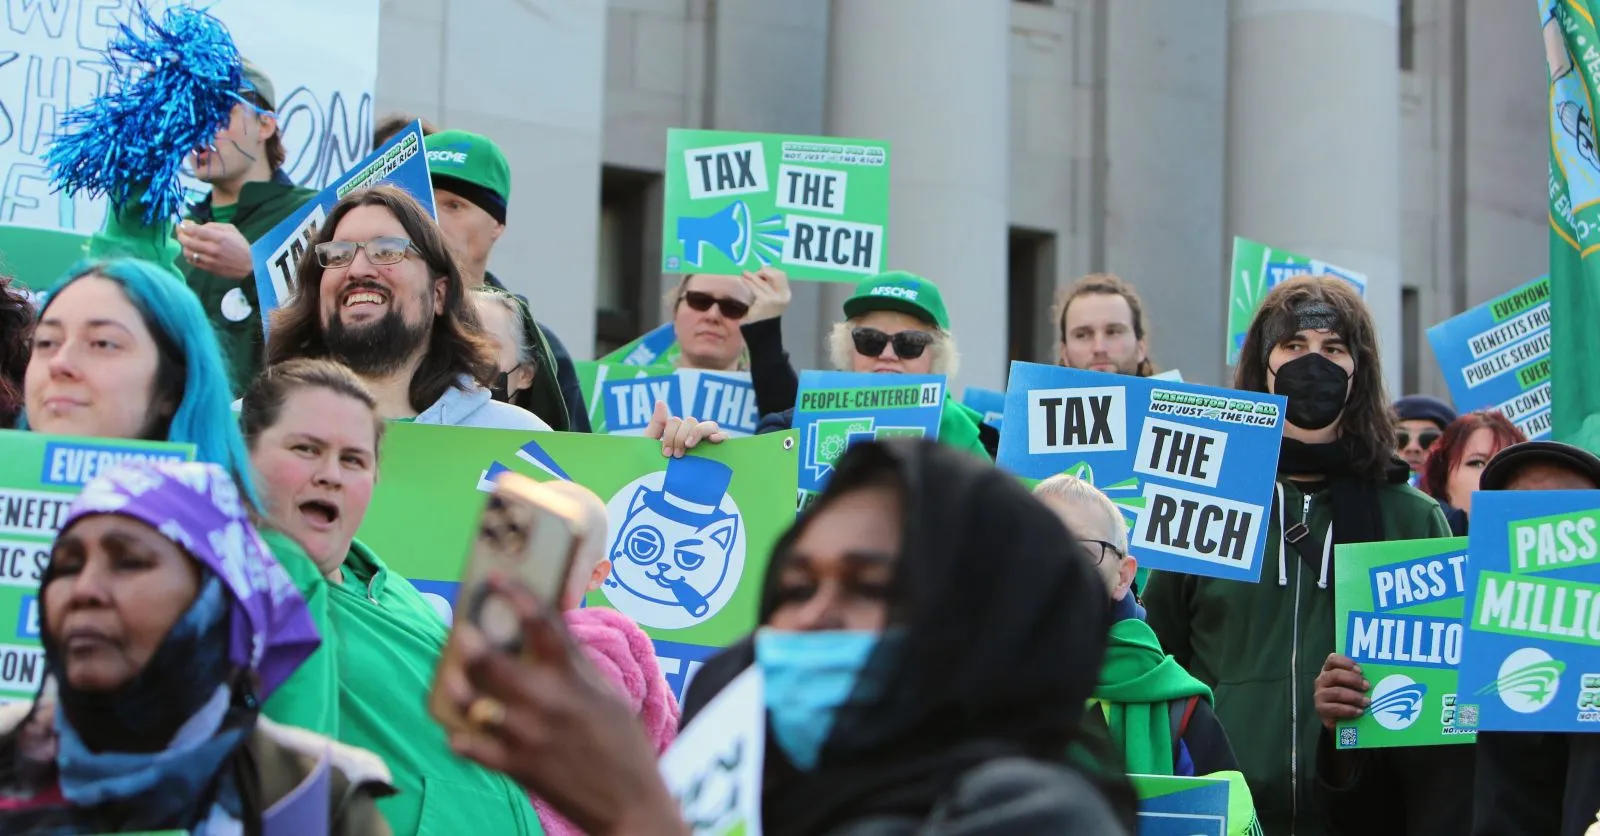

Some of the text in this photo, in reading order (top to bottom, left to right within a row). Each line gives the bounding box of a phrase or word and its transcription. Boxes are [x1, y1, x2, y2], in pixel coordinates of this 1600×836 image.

[426, 150, 468, 164] FSCME
[694, 150, 757, 192] TAX
[787, 171, 837, 208] THE
[793, 222, 874, 268] RICH
[870, 286, 918, 301] AFSCME
[1472, 308, 1550, 354] BENEFITS FRO
[1466, 333, 1550, 384] PUBLIC SERVIC
[801, 387, 937, 409] PEOPLE-CENTERED AI
[1039, 395, 1114, 446] TAX
[1151, 403, 1275, 426] NOT JUST THE RICH
[1153, 391, 1277, 416] WASHINGTON FOR ALL
[1150, 426, 1214, 480] THE
[1145, 494, 1252, 561] RICH
[1515, 517, 1597, 569] PASS
[1376, 560, 1446, 608] PASS
[1479, 578, 1600, 640] MILLIO
[1351, 617, 1463, 665] MILLIO
